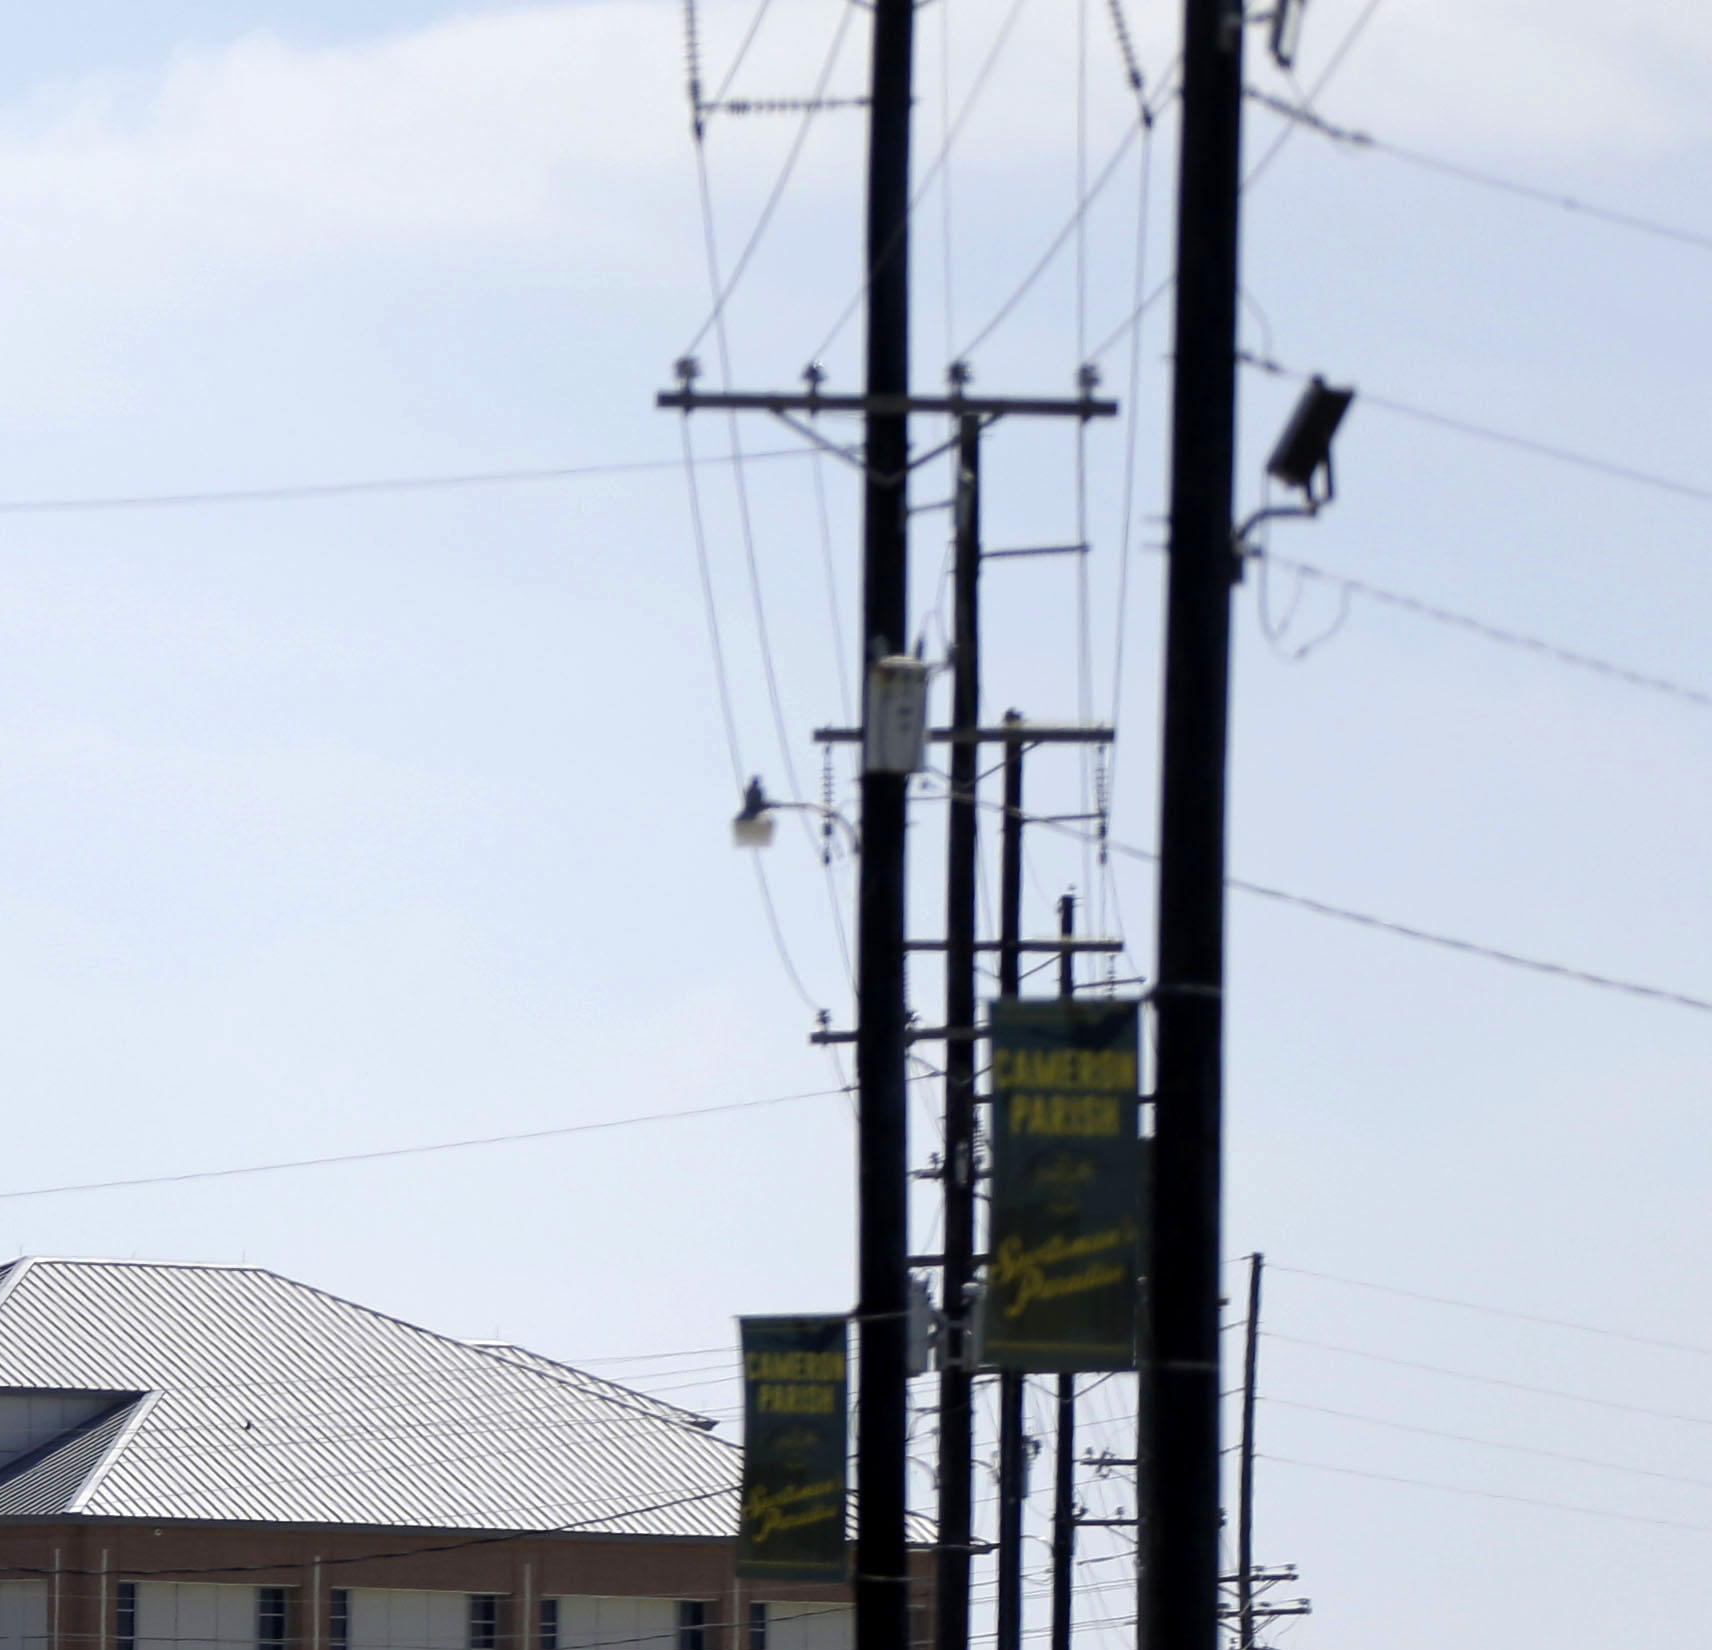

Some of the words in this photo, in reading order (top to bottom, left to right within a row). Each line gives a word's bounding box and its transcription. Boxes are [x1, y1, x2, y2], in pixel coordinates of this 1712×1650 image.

[995, 1050, 1136, 1088] CAMERON
[1009, 1095, 1119, 1134] PARISH
[747, 1352, 844, 1380] CAMERON
[759, 1385, 834, 1413] PARISH
